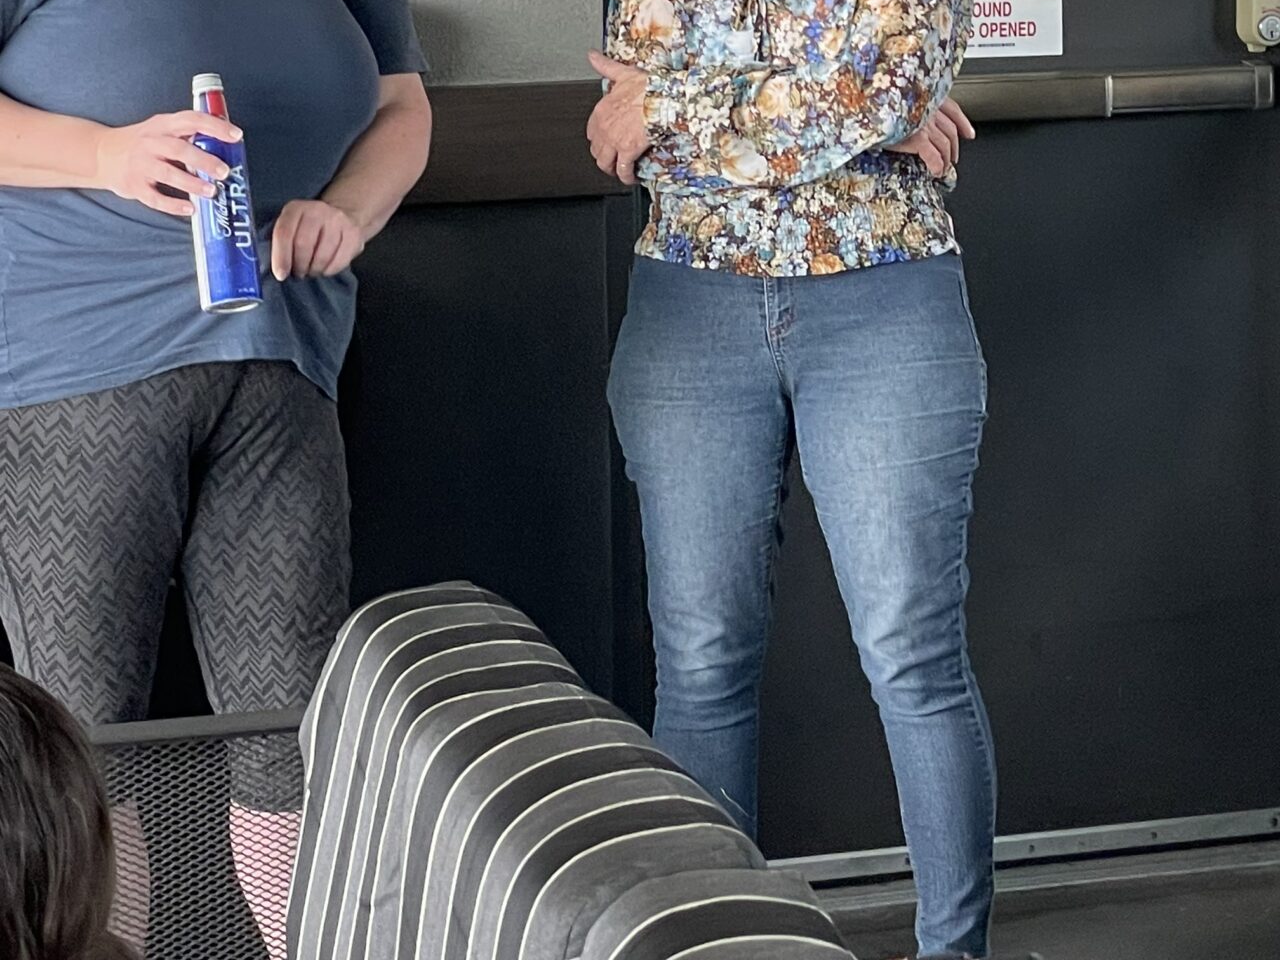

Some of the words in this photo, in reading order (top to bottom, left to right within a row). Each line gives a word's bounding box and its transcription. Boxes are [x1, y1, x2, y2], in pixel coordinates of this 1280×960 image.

[972, 1, 1012, 17] OUND
[979, 21, 1037, 38] OPENED
[229, 164, 252, 248] ULTRA
